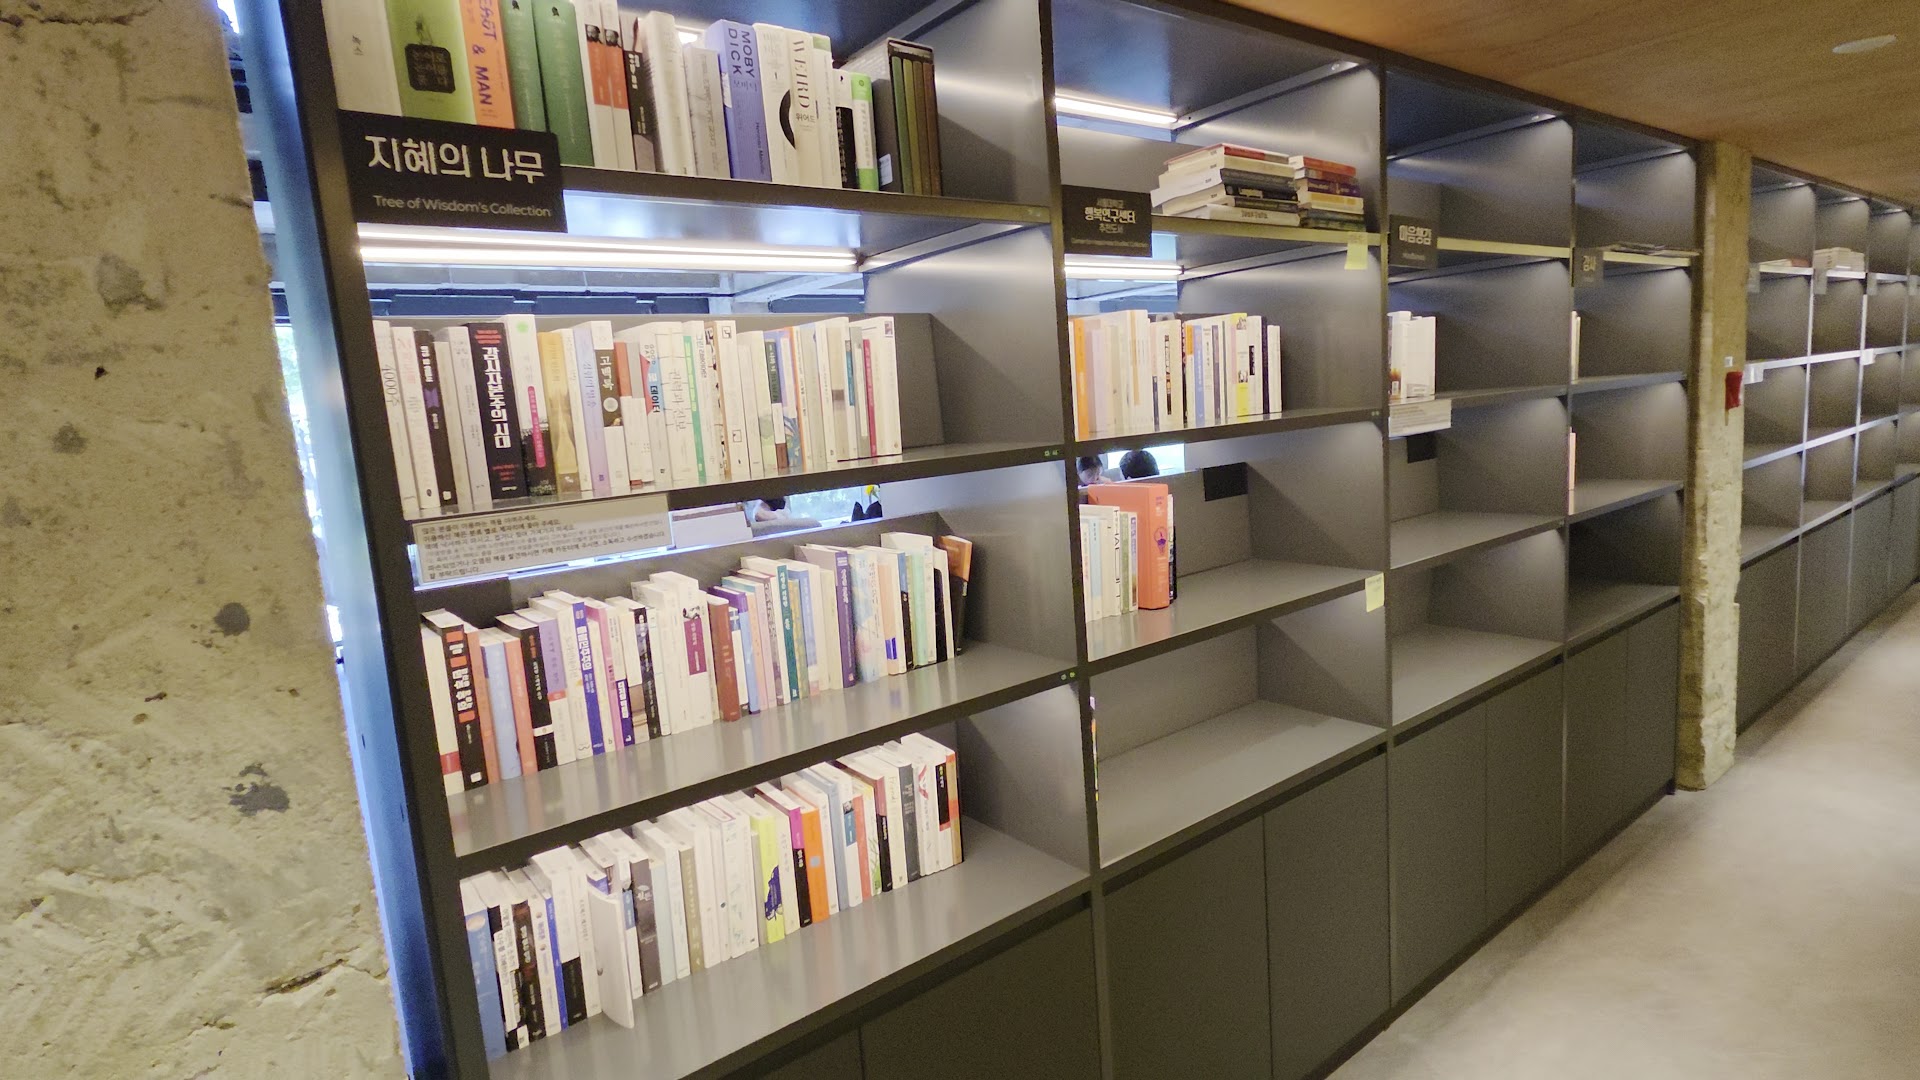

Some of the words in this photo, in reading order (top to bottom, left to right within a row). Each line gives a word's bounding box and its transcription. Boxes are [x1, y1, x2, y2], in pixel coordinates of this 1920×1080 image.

[727, 28, 742, 76] DICK
[741, 30, 756, 79] MOBY
[792, 40, 810, 108] WEIRD
[474, 65, 493, 107] MAN
[794, 112, 816, 123] 위어드
[365, 135, 471, 179] 지혜의
[480, 146, 545, 184] 나무
[373, 194, 404, 209] Tree
[406, 197, 422, 210] of
[422, 198, 489, 214] Wisdom's
[489, 202, 552, 217] Collection
[1084, 206, 1136, 224] 행복연구센터
